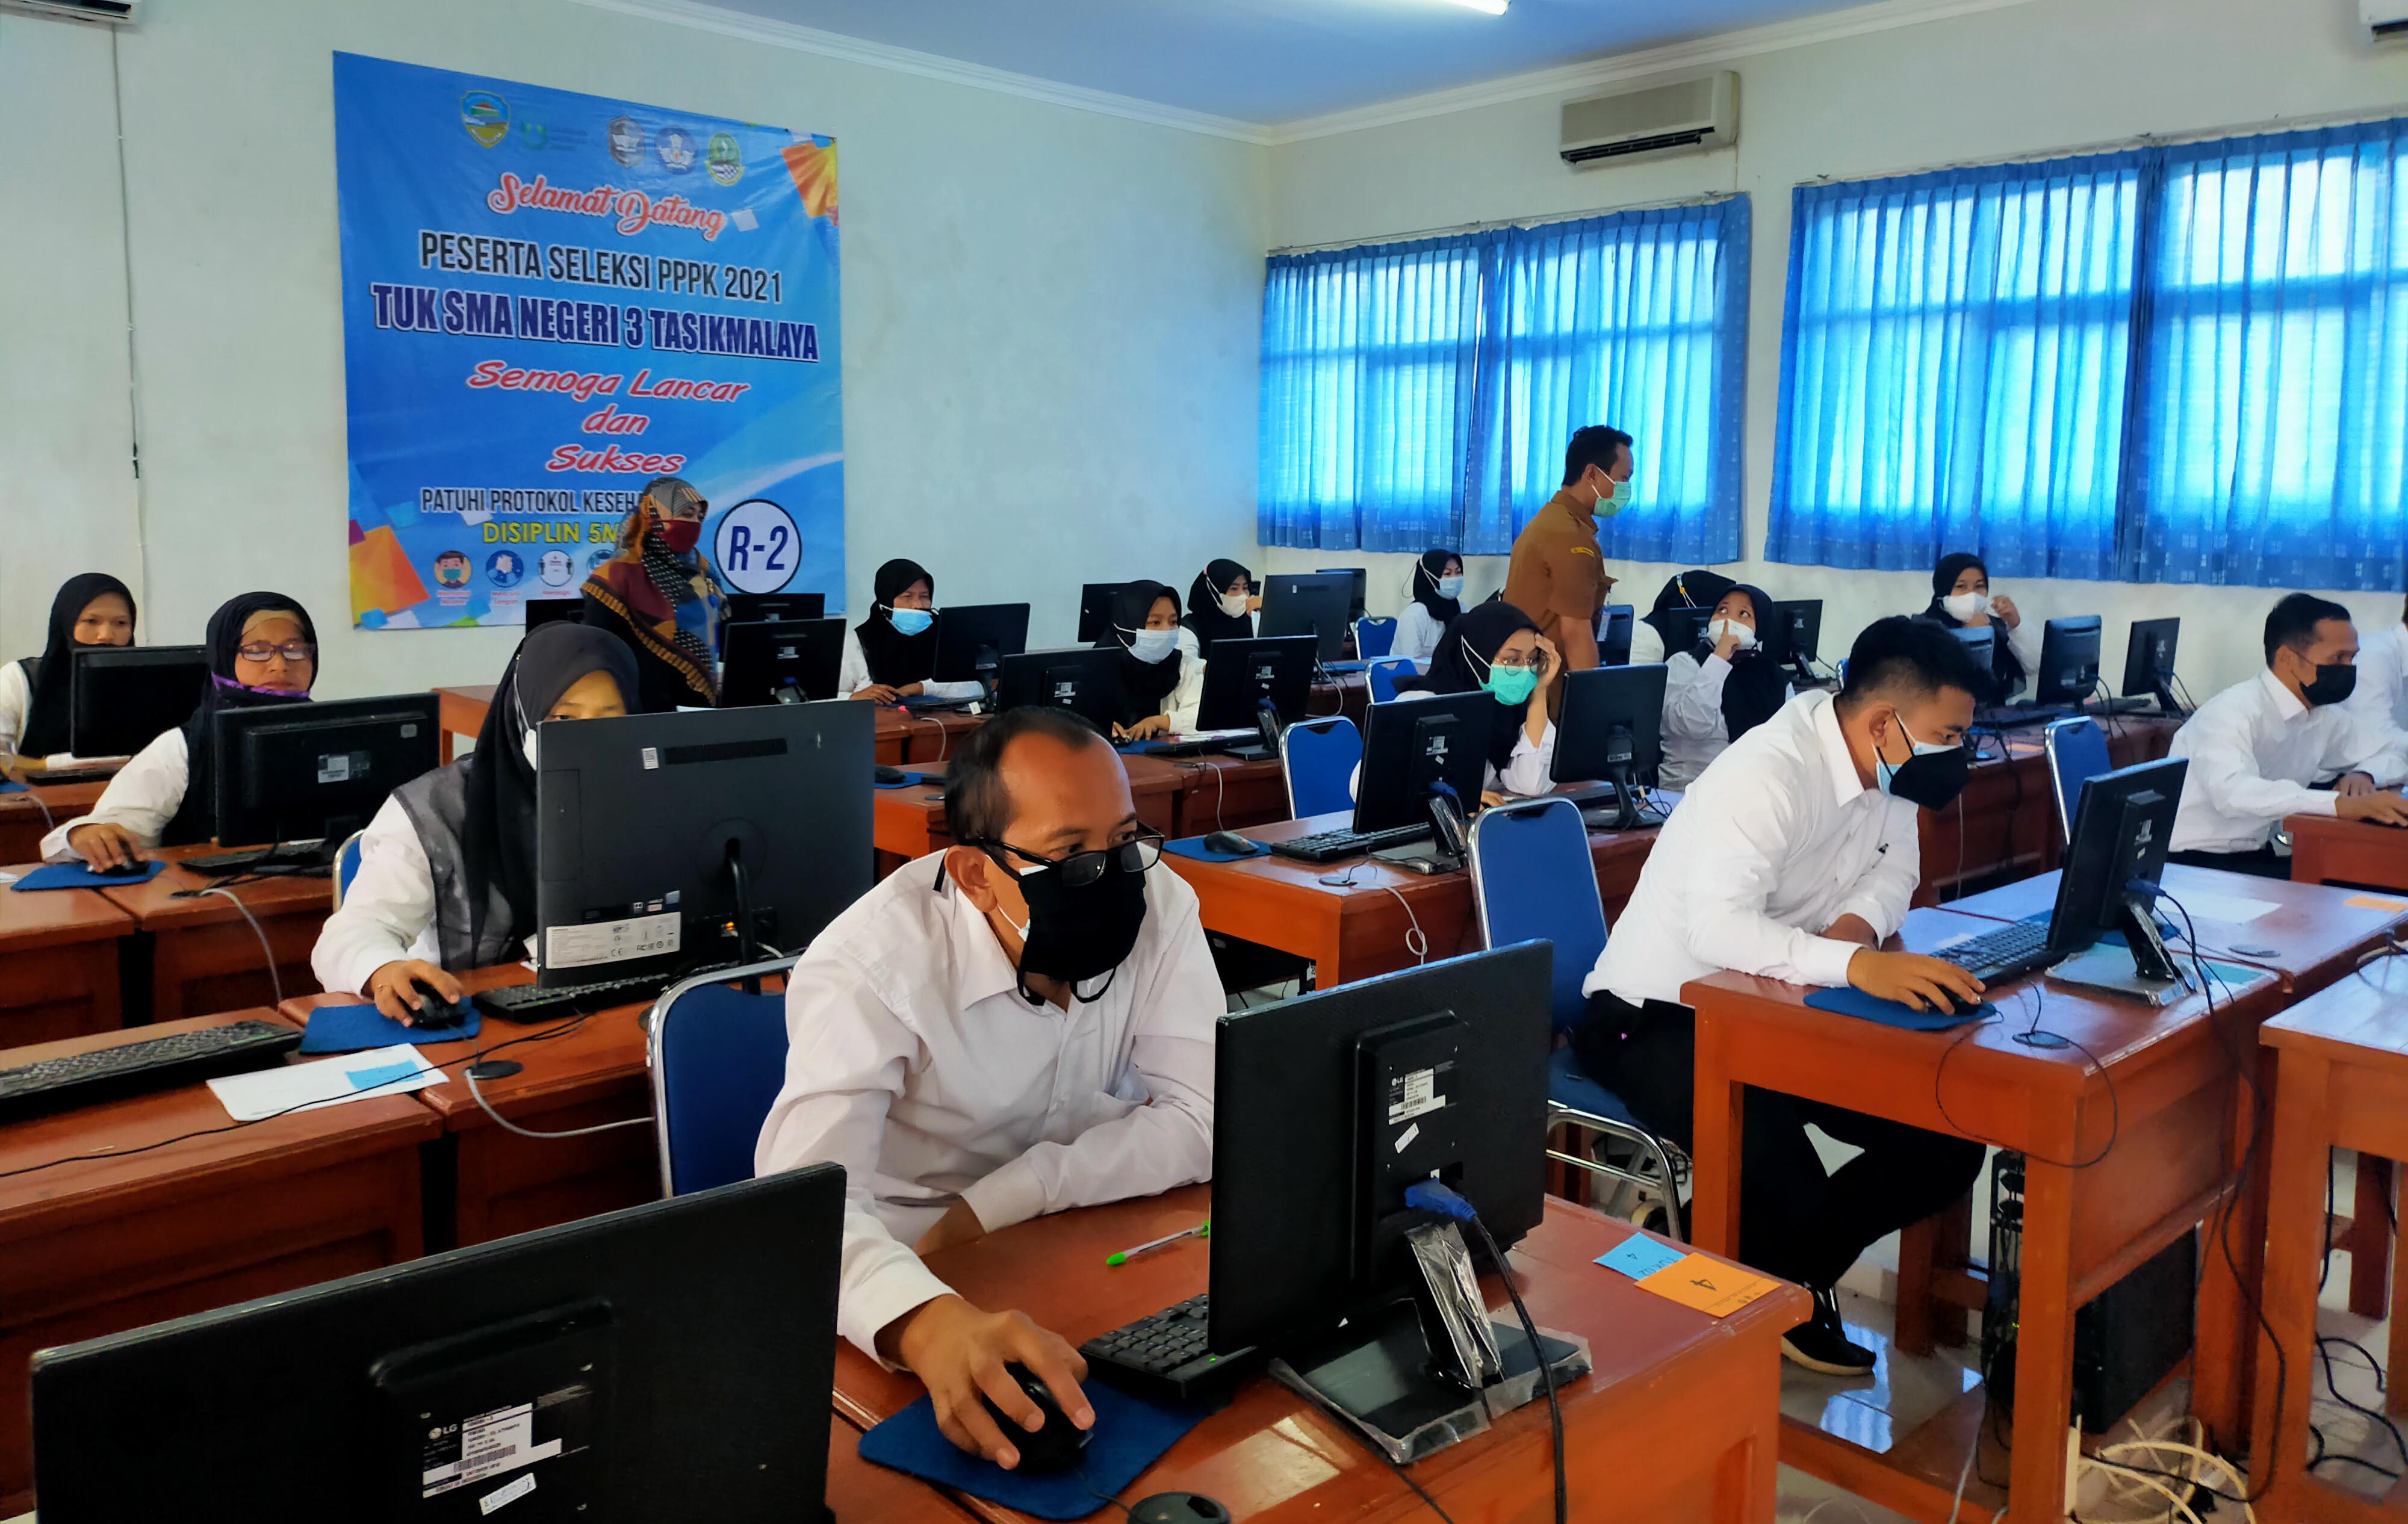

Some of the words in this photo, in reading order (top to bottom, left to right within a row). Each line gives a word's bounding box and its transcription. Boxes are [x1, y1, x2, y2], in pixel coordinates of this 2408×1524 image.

[489, 174, 621, 214] Selamat
[616, 191, 723, 240] Datang
[422, 232, 542, 277] PESERTA
[549, 246, 650, 289] SELEKSI
[658, 258, 718, 296] PPPK
[725, 267, 781, 302] 2021
[373, 284, 438, 330] TUK
[444, 290, 514, 336] SMA
[520, 297, 619, 344] NEGERI
[625, 307, 644, 347] 3
[649, 309, 819, 361] TASIKMALAYA
[468, 361, 622, 400] Semoga
[629, 370, 750, 401] Lancar
[583, 404, 648, 433] dan
[547, 445, 686, 472] Sukses
[422, 488, 484, 512] PATUHI
[491, 490, 579, 513] PROTOKOL
[483, 521, 580, 543] DISIPLIN
[728, 525, 788, 571] R-2
[1689, 1278, 1717, 1291] 4
